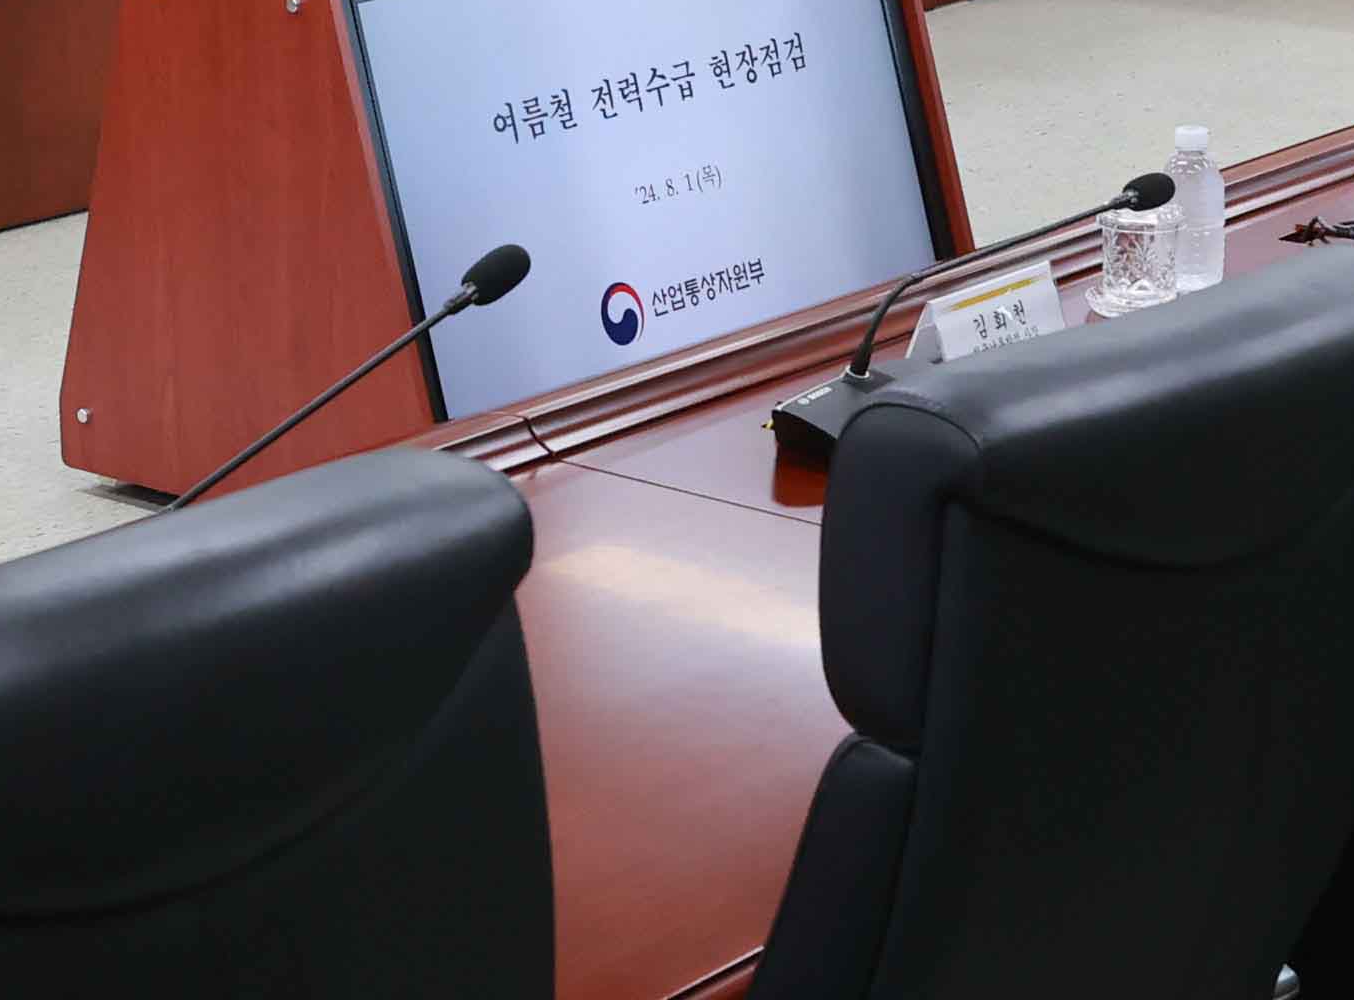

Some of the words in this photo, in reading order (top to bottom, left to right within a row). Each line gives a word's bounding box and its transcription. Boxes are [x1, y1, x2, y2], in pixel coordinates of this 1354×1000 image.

[492, 88, 579, 145] 여름철
[590, 60, 696, 121] 전력수급
[707, 31, 808, 90] 현장점검
[650, 257, 766, 319] 산업통상자원부
